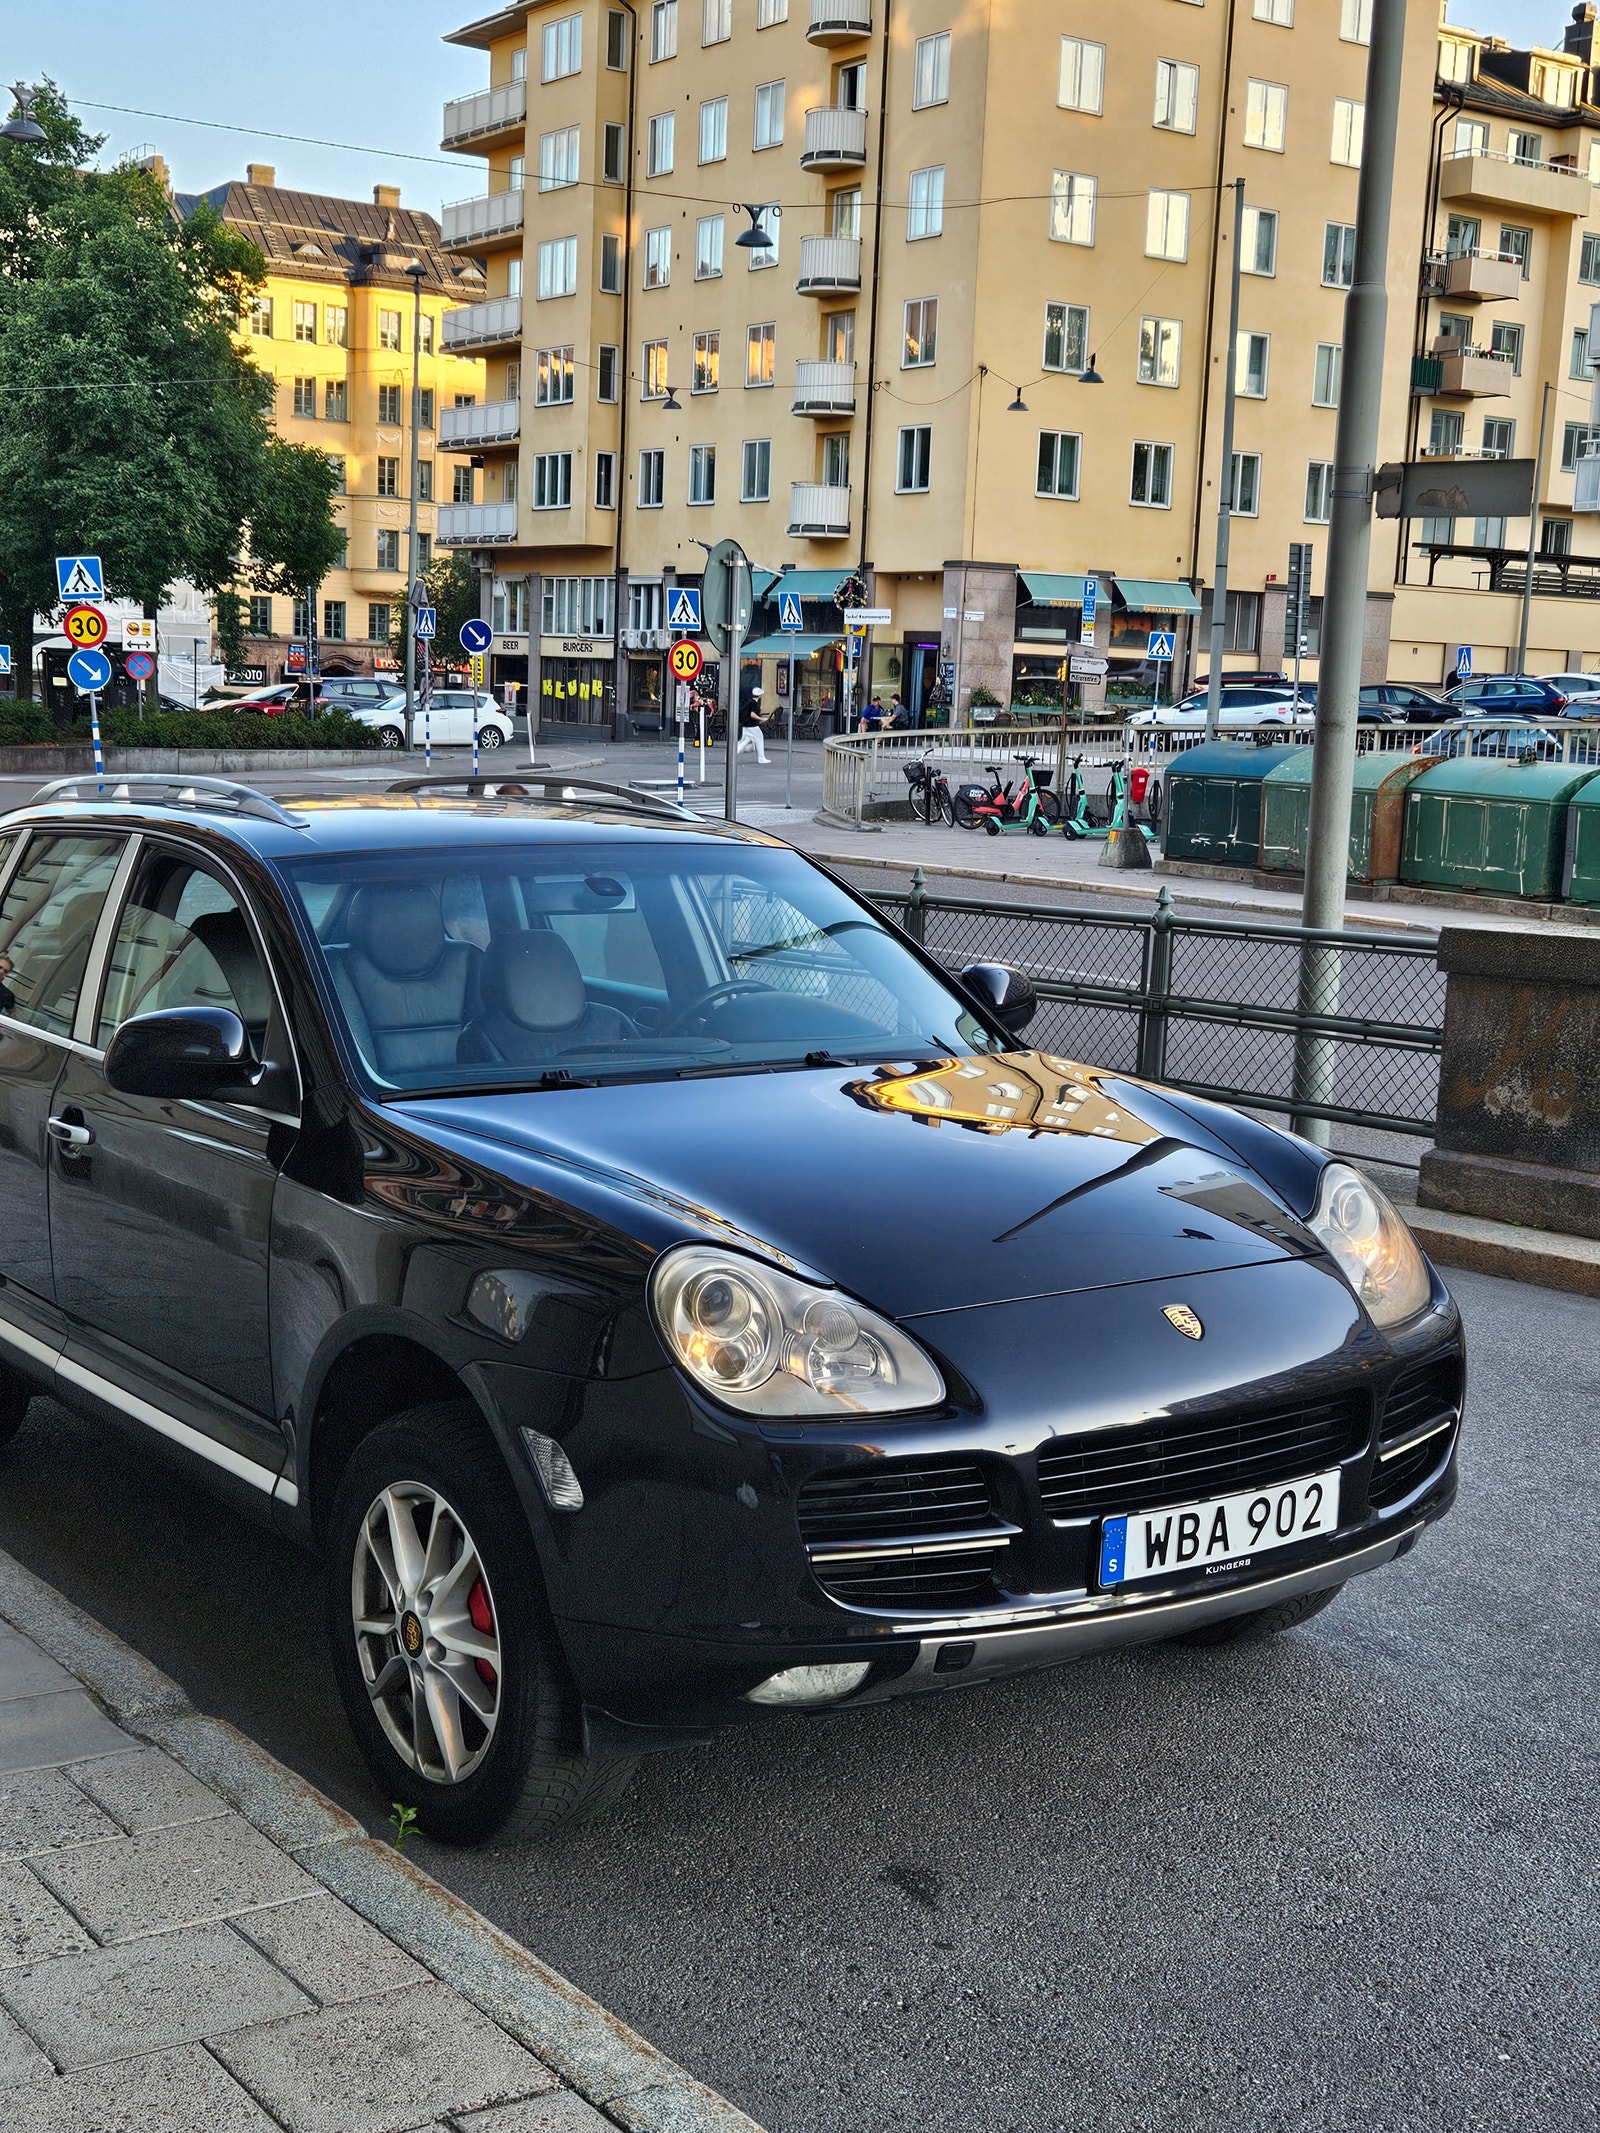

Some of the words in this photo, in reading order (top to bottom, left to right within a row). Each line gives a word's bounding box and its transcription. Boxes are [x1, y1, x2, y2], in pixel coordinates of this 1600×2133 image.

[1086, 581, 1095, 596] P
[71, 617, 101, 637] 30
[502, 640, 519, 650] BEER
[562, 642, 593, 653] BURGERS
[675, 650, 698, 670] 30
[542, 679, 603, 700] KLUNK
[1145, 1505, 1230, 1569] WBA
[1247, 1482, 1323, 1547] 902
[1108, 1558, 1118, 1573] S
